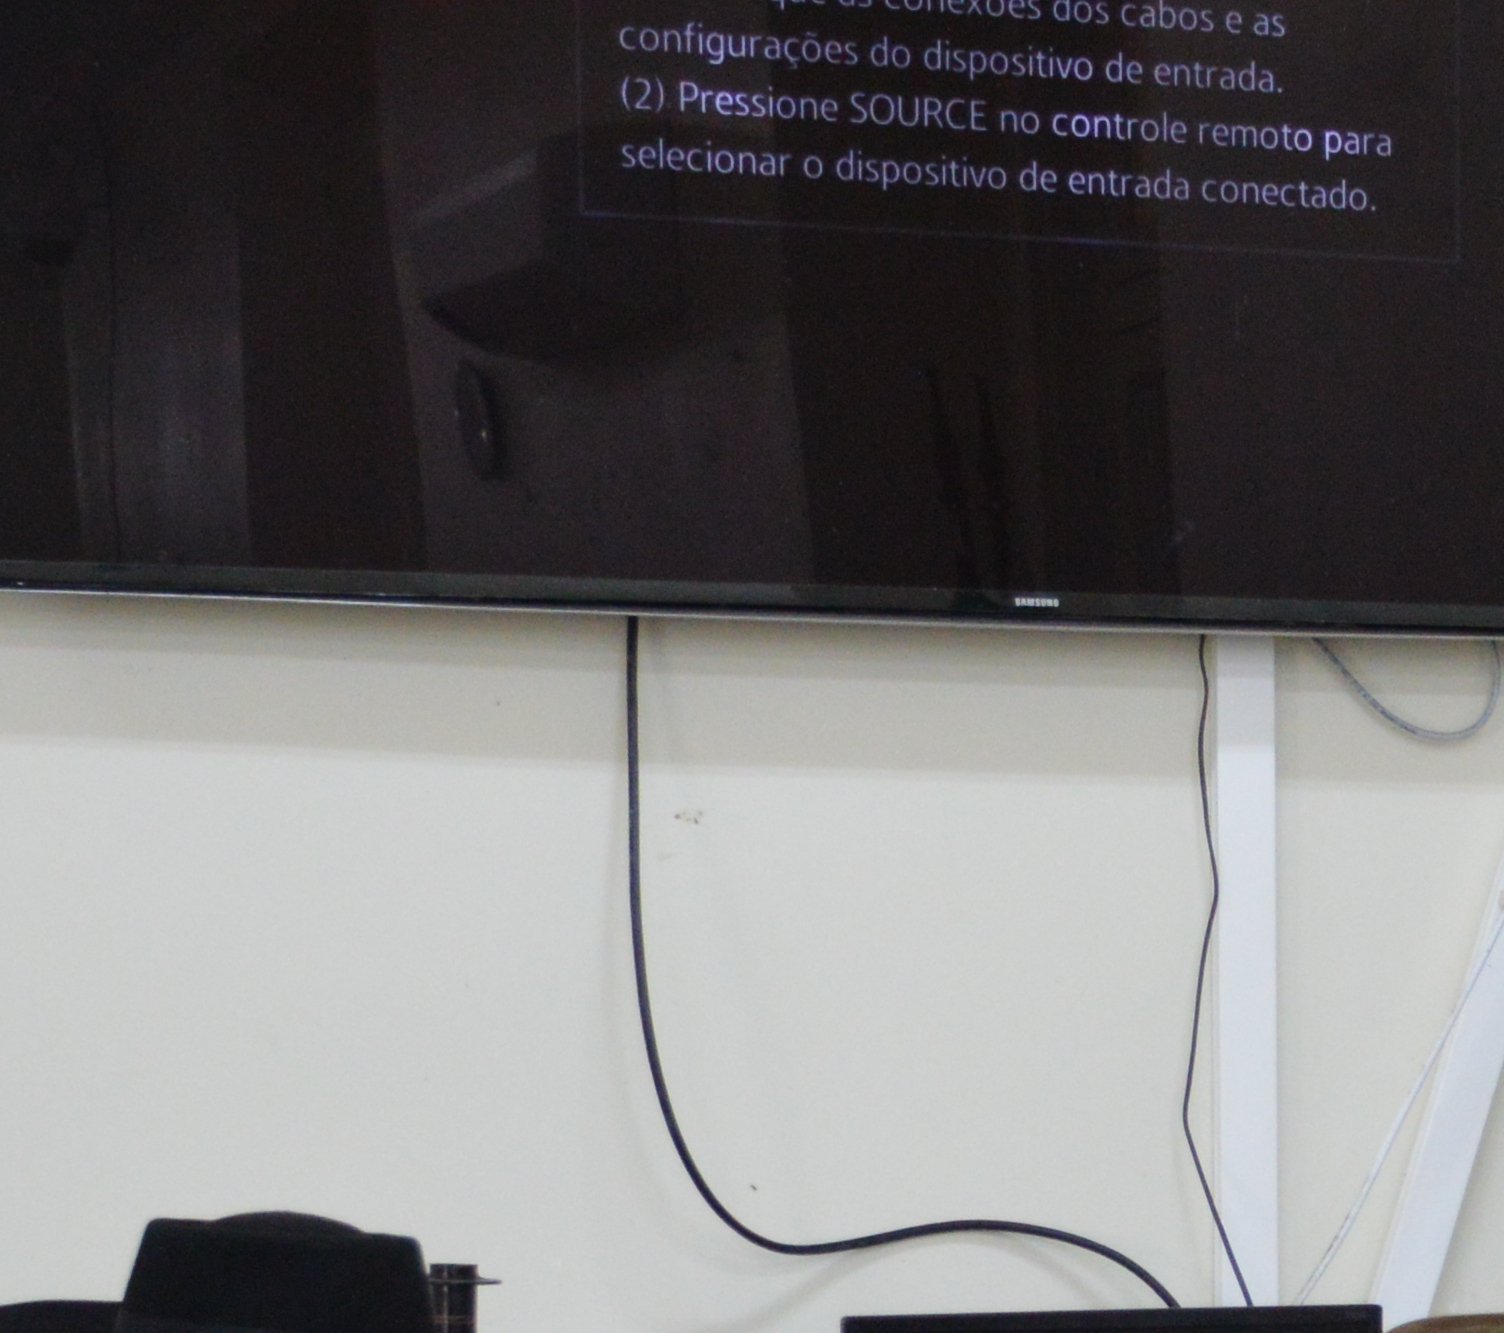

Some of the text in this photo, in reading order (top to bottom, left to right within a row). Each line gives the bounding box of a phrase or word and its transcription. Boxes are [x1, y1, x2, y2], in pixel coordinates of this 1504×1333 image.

[1053, 0, 1109, 24] dos
[1120, 0, 1214, 32] cabos
[1225, 11, 1243, 35] e
[1253, 12, 1286, 37] as
[619, 22, 1284, 93] configurações do dispositivo de entrada.
[621, 76, 1393, 161] (2) Pressione SOURCE no controle remoto para
[621, 138, 1377, 212] selecionar o dispositivo de entrada conectado.
